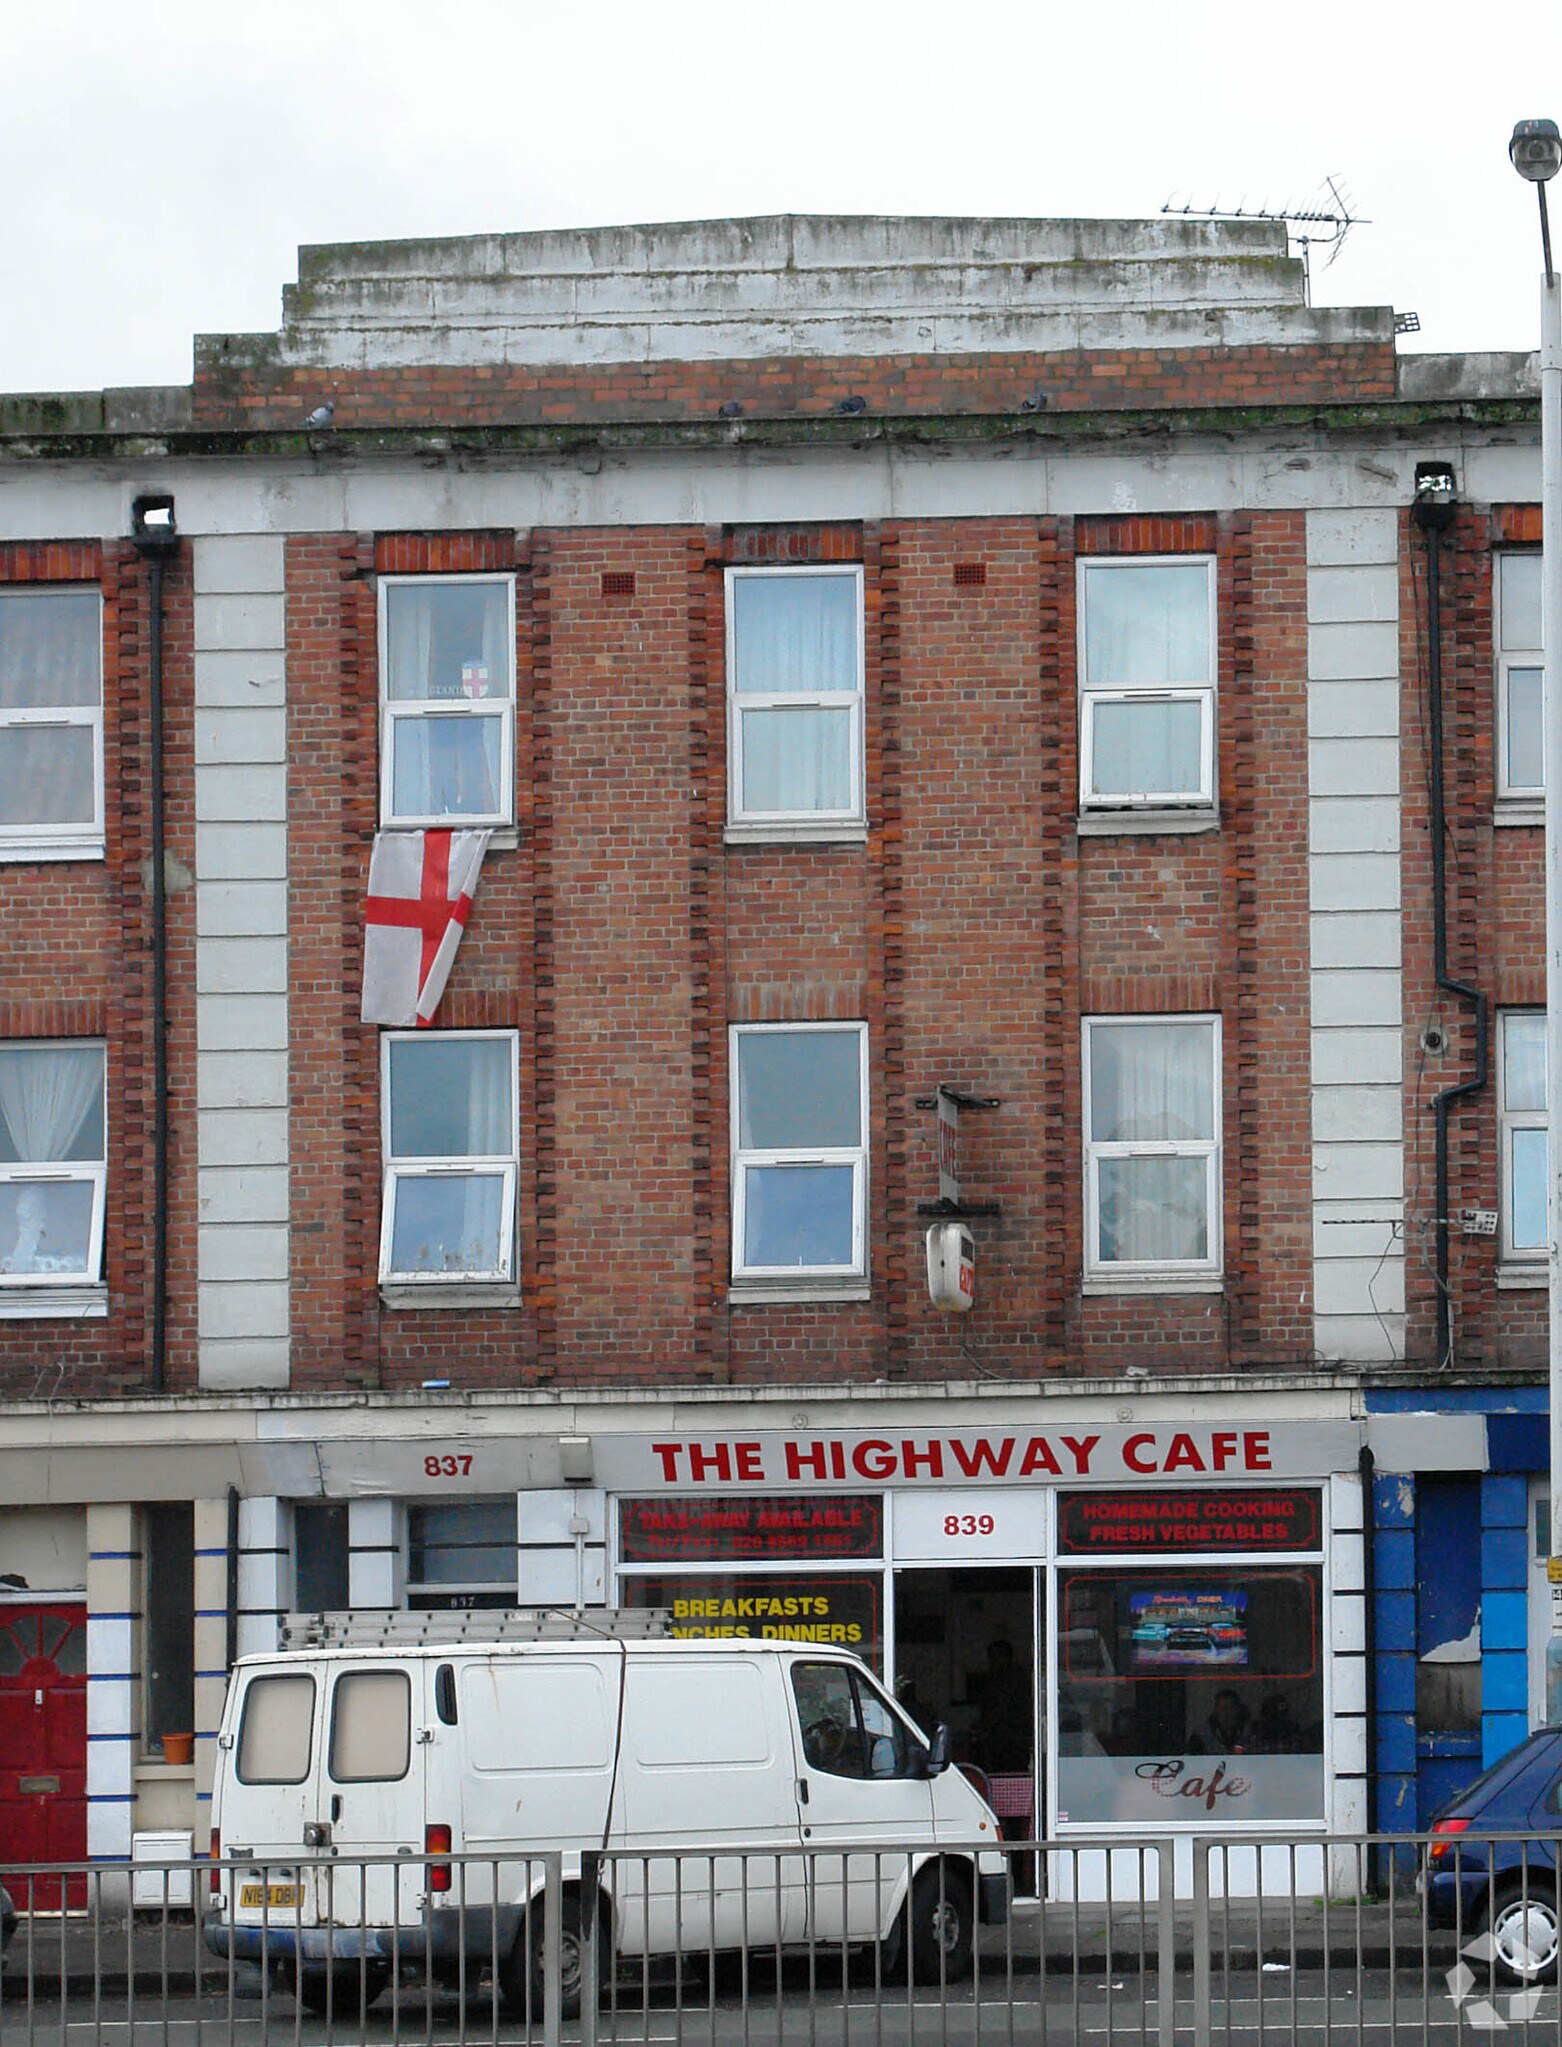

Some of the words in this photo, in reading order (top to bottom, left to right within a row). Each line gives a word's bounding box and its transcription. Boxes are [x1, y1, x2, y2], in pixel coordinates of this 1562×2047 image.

[424, 1455, 473, 1477] 837
[652, 1442, 765, 1482] THE
[784, 1435, 1101, 1480] HIGHWAY
[1122, 1431, 1273, 1474] CAFE
[639, 1510, 750, 1530] TAKE-AWAY
[756, 1508, 863, 1529] AVAILABLE
[1083, 1502, 1198, 1520] HOMEMADE
[1203, 1500, 1295, 1517] COOKING
[943, 1514, 995, 1536] 839
[1090, 1525, 1156, 1542] FRESH
[1161, 1522, 1289, 1540] VEGETABLES
[731, 1534, 763, 1550] 020
[673, 1596, 830, 1619] BREAKFASTS
[672, 1624, 750, 1640] NCHES
[762, 1623, 863, 1643] DINNERS
[1135, 1759, 1252, 1811] Cafe
